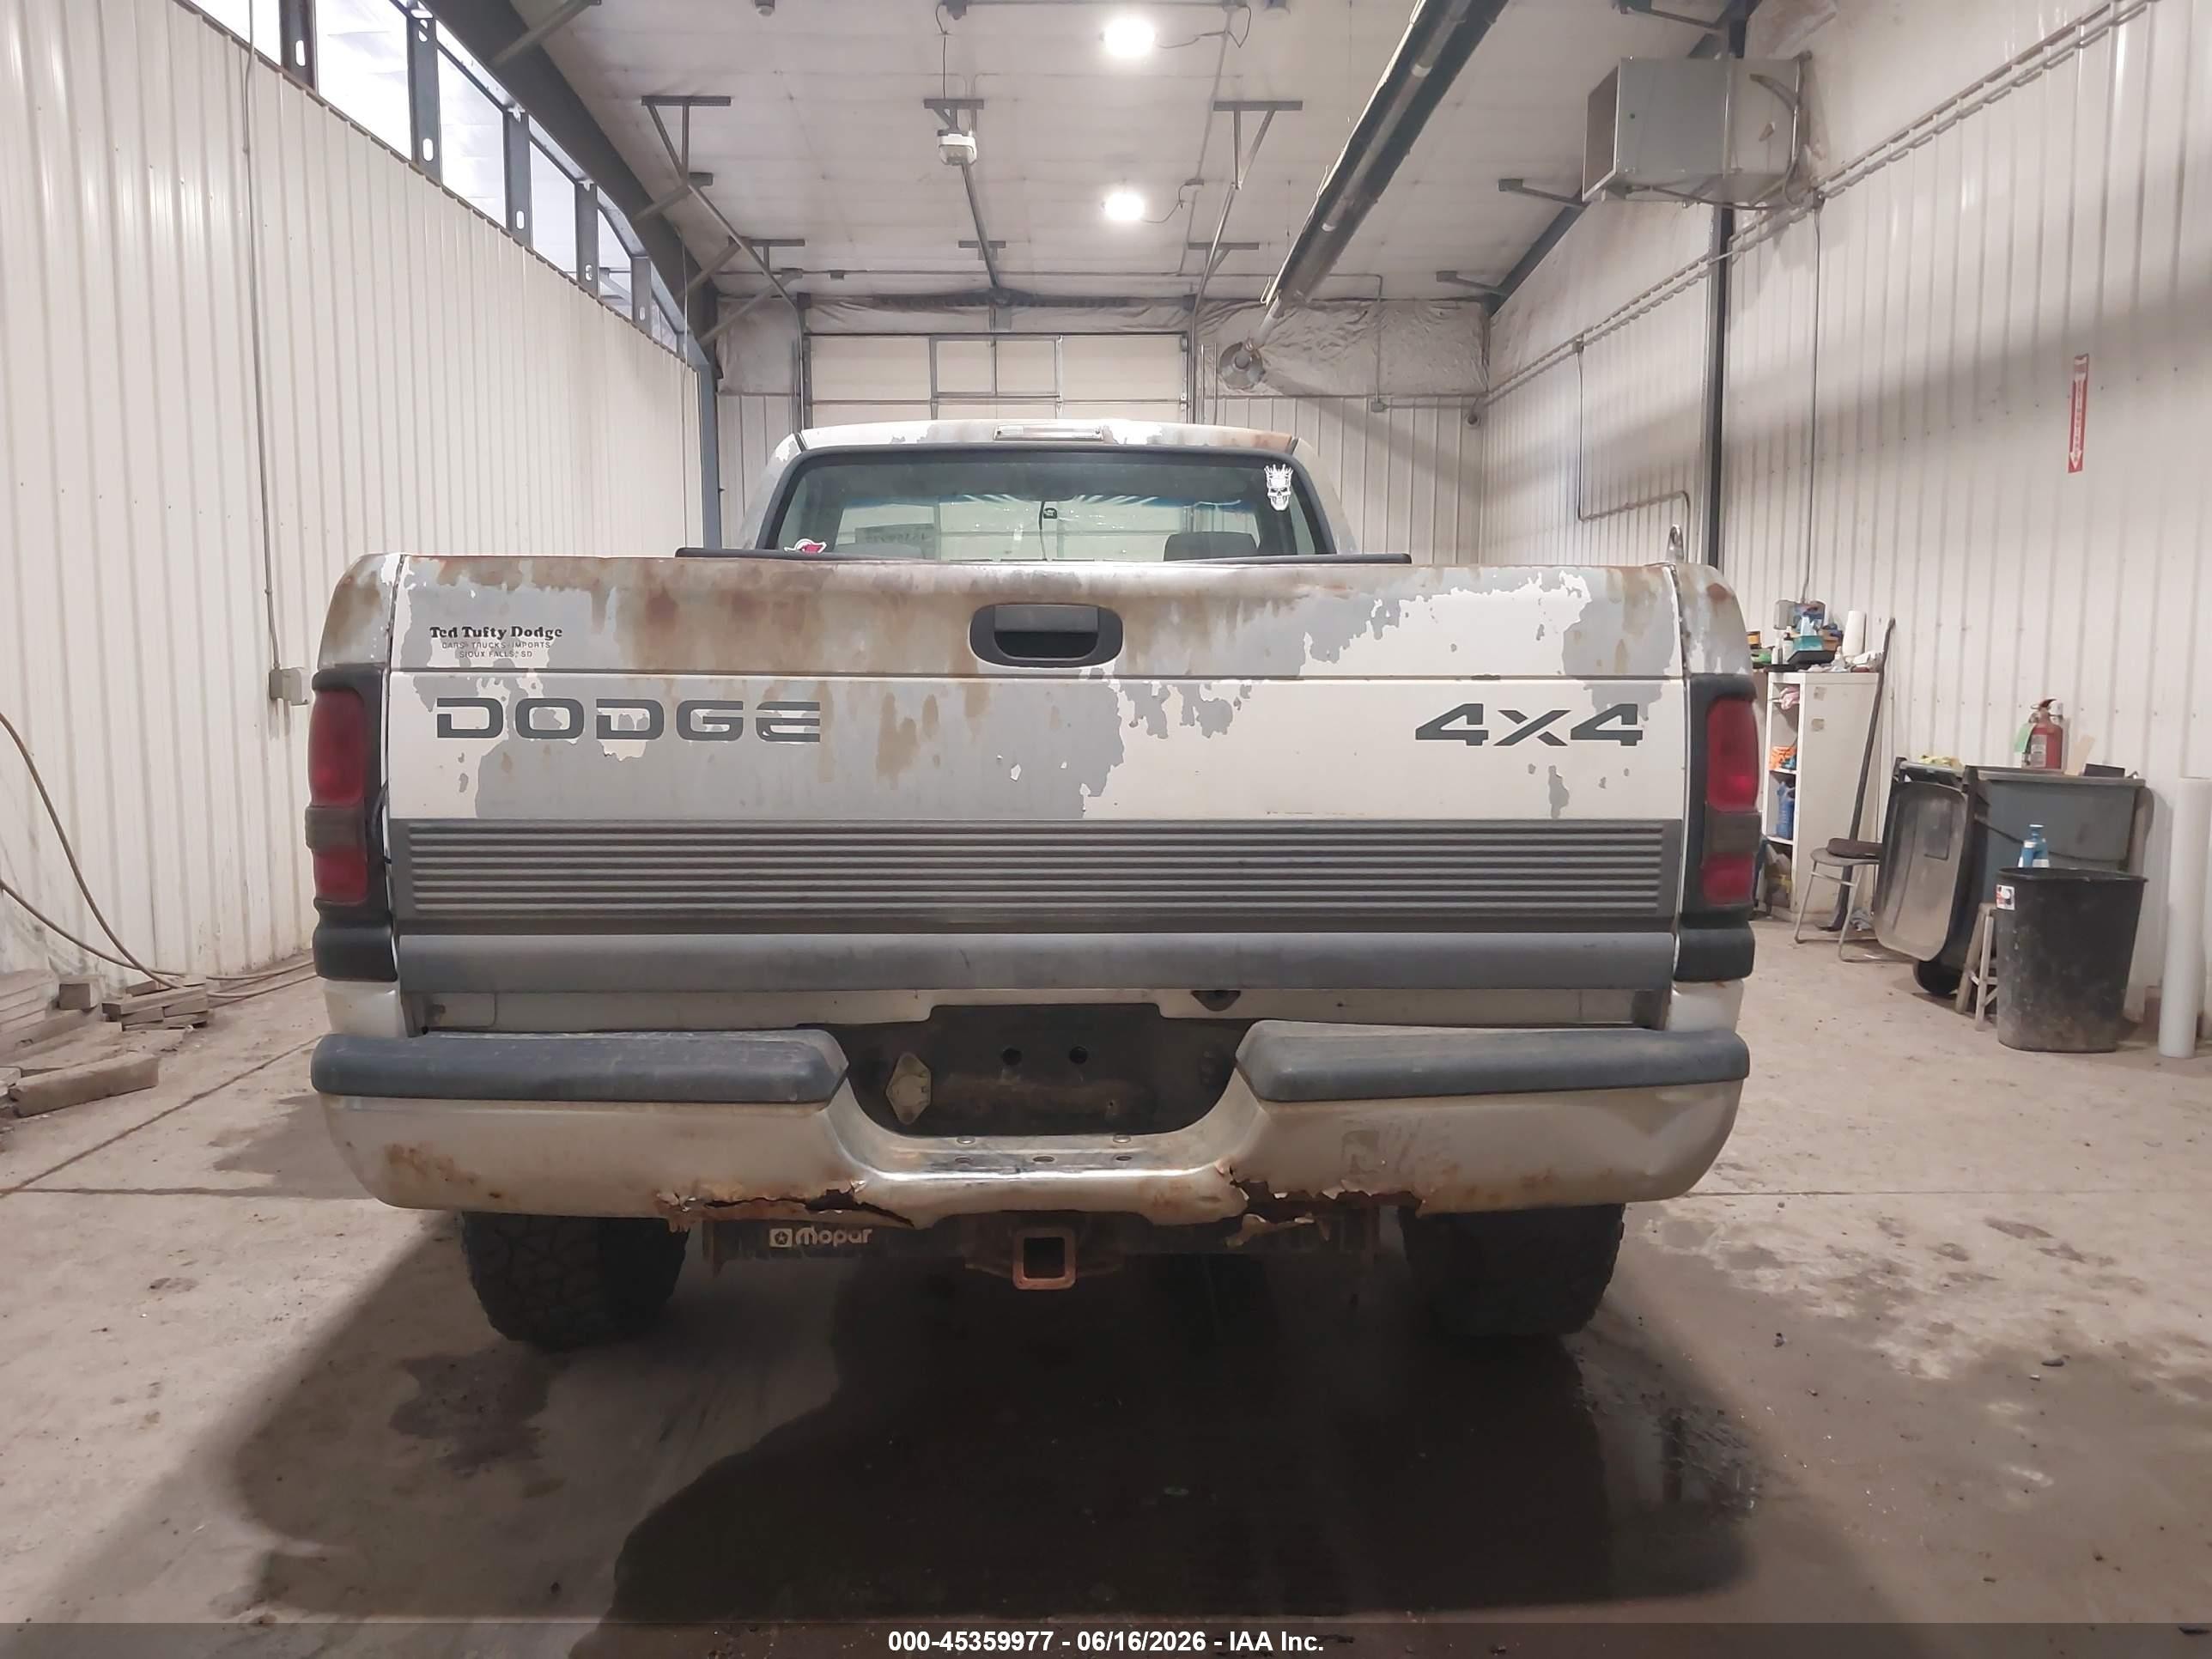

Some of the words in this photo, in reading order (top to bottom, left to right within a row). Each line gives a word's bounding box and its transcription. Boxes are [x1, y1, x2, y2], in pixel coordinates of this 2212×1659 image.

[429, 626, 458, 638] Ted
[461, 626, 507, 640] Tufty
[510, 626, 562, 641] Dodge
[436, 697, 821, 744] DODGE
